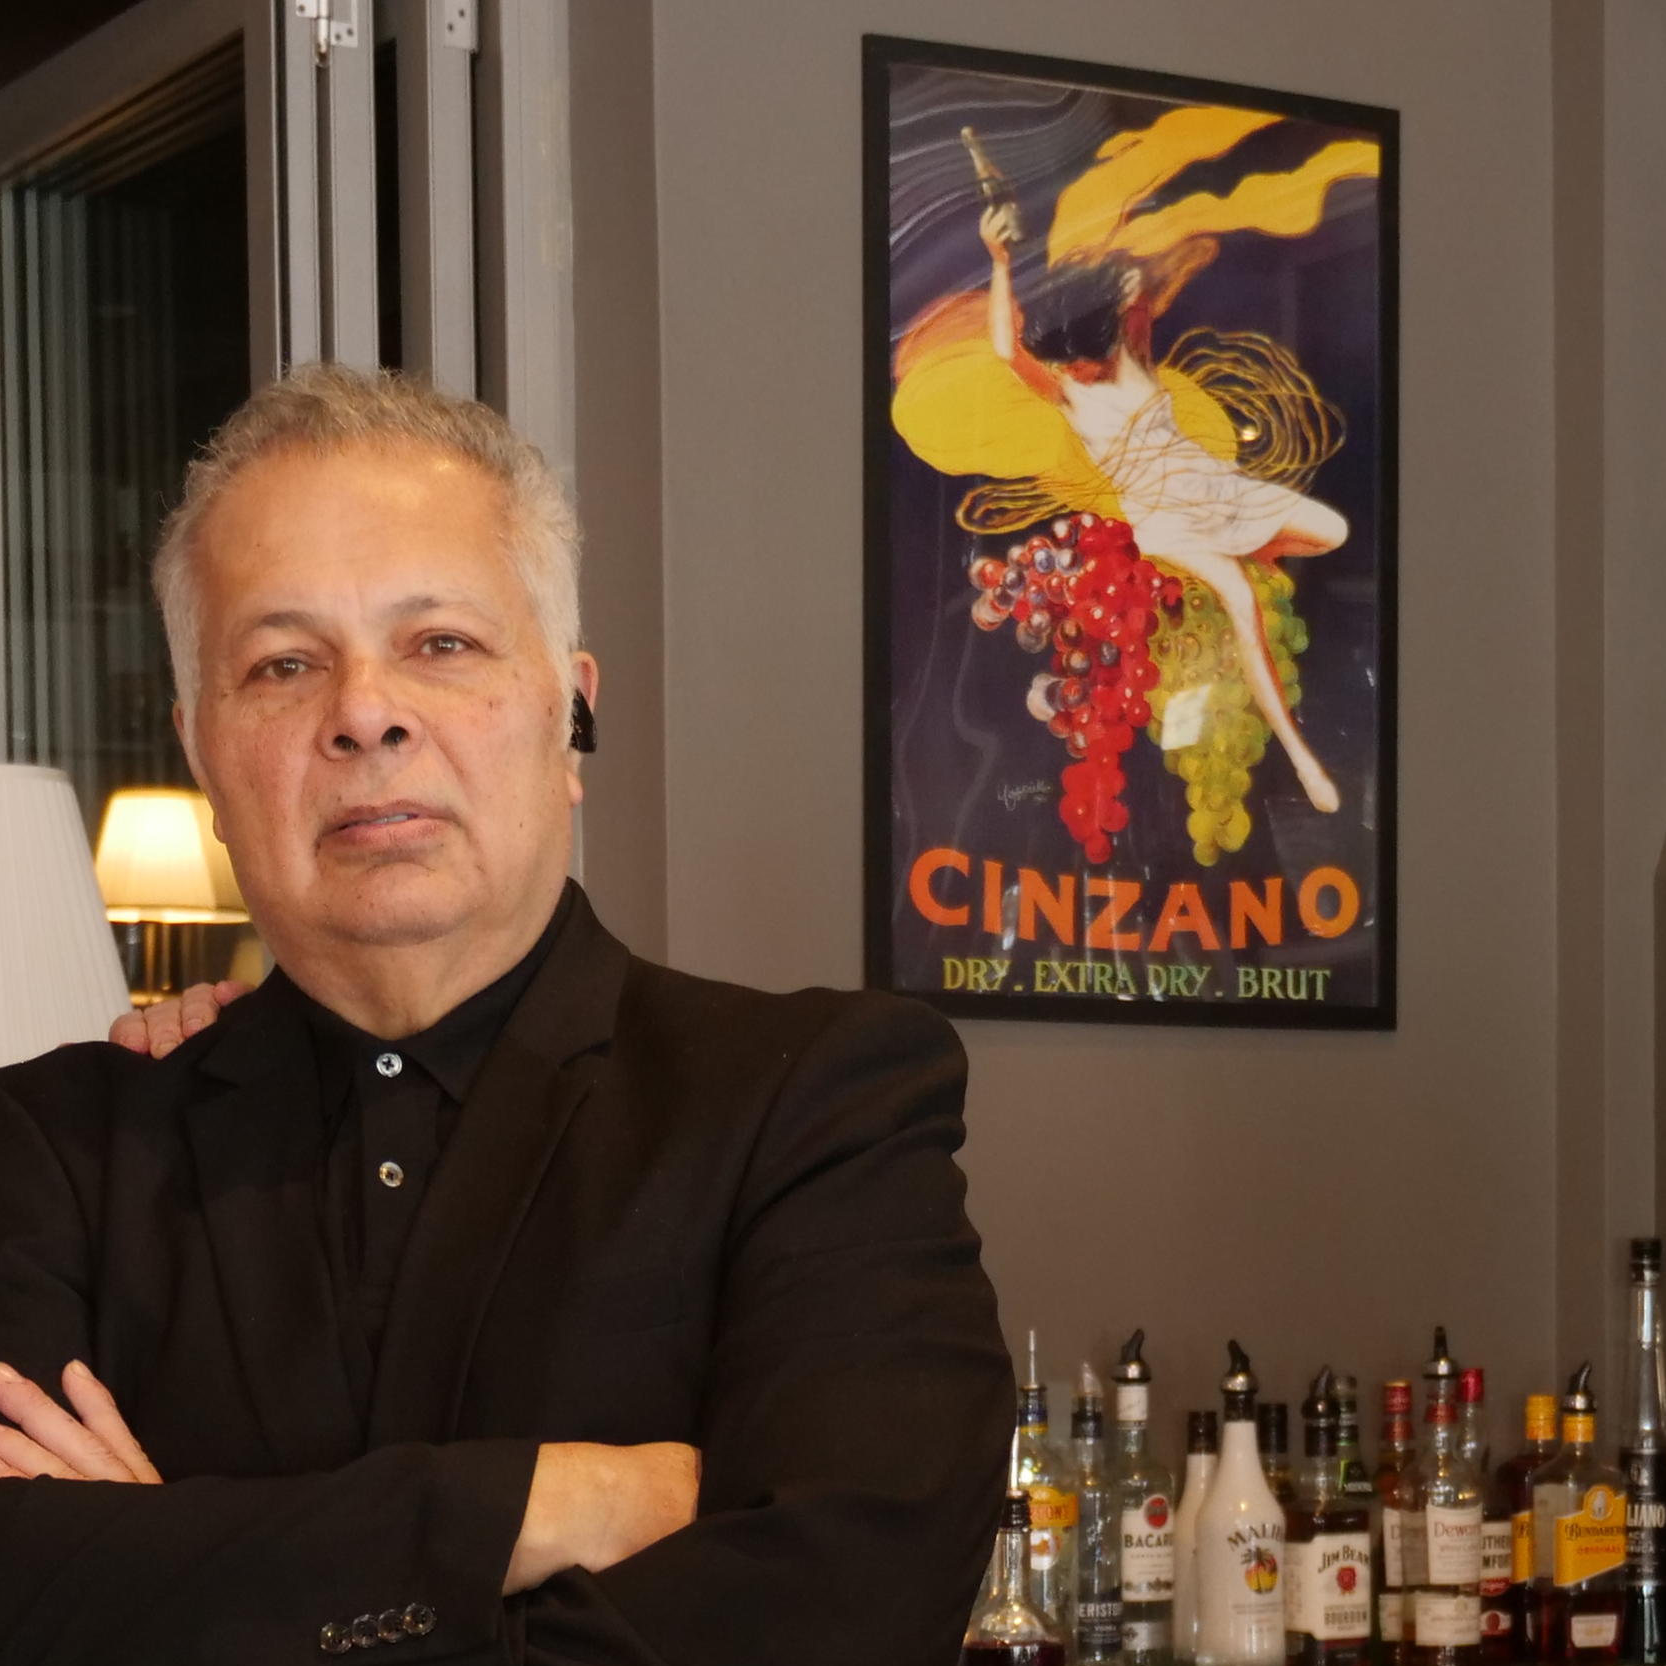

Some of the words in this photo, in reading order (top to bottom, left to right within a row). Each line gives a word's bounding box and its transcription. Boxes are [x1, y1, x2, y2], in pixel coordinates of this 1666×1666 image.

[908, 847, 1361, 952] CINZANO
[1033, 960, 1137, 996] EXTRA
[1236, 967, 1330, 1001] BRUT
